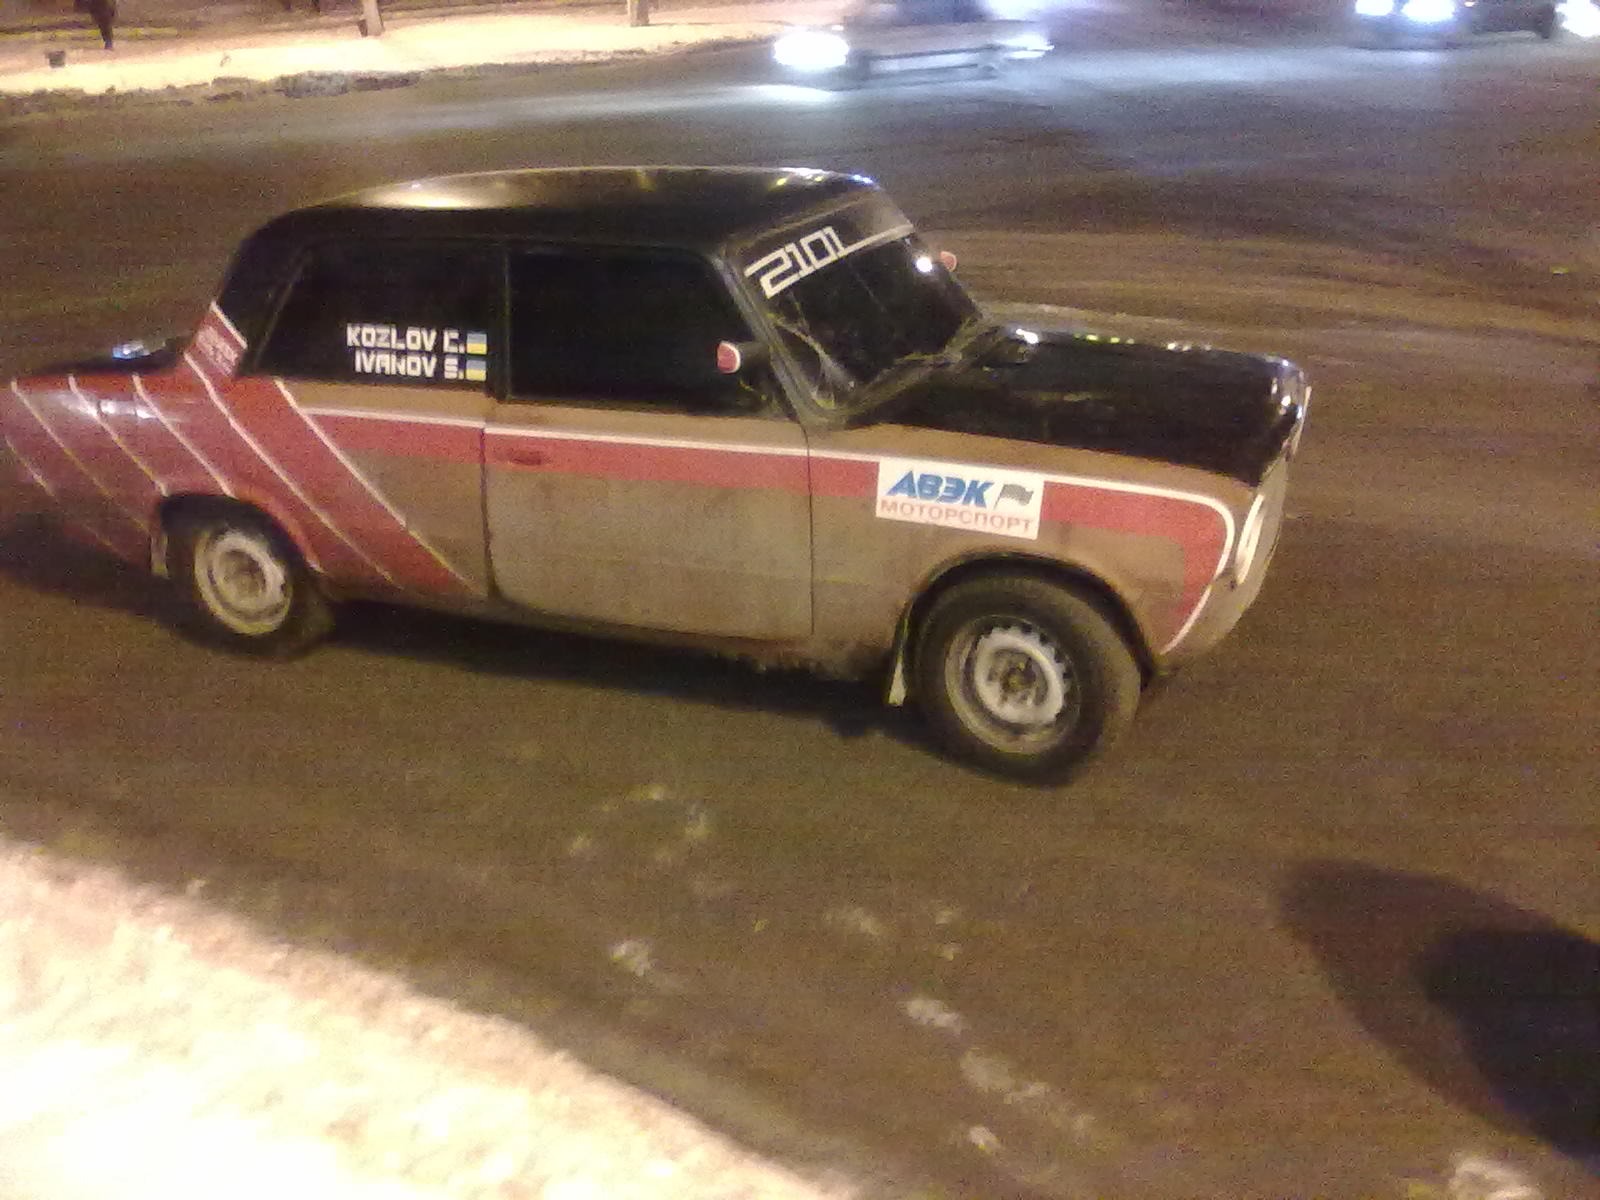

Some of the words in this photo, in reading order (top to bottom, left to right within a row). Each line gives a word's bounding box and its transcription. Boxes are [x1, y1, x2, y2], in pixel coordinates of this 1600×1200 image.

[744, 226, 850, 299] 2101
[346, 322, 437, 352] KOZLOV
[355, 350, 437, 378] IVANOV
[886, 470, 995, 508] АВЭК
[879, 499, 1034, 532] МОТОРСПОРТ
